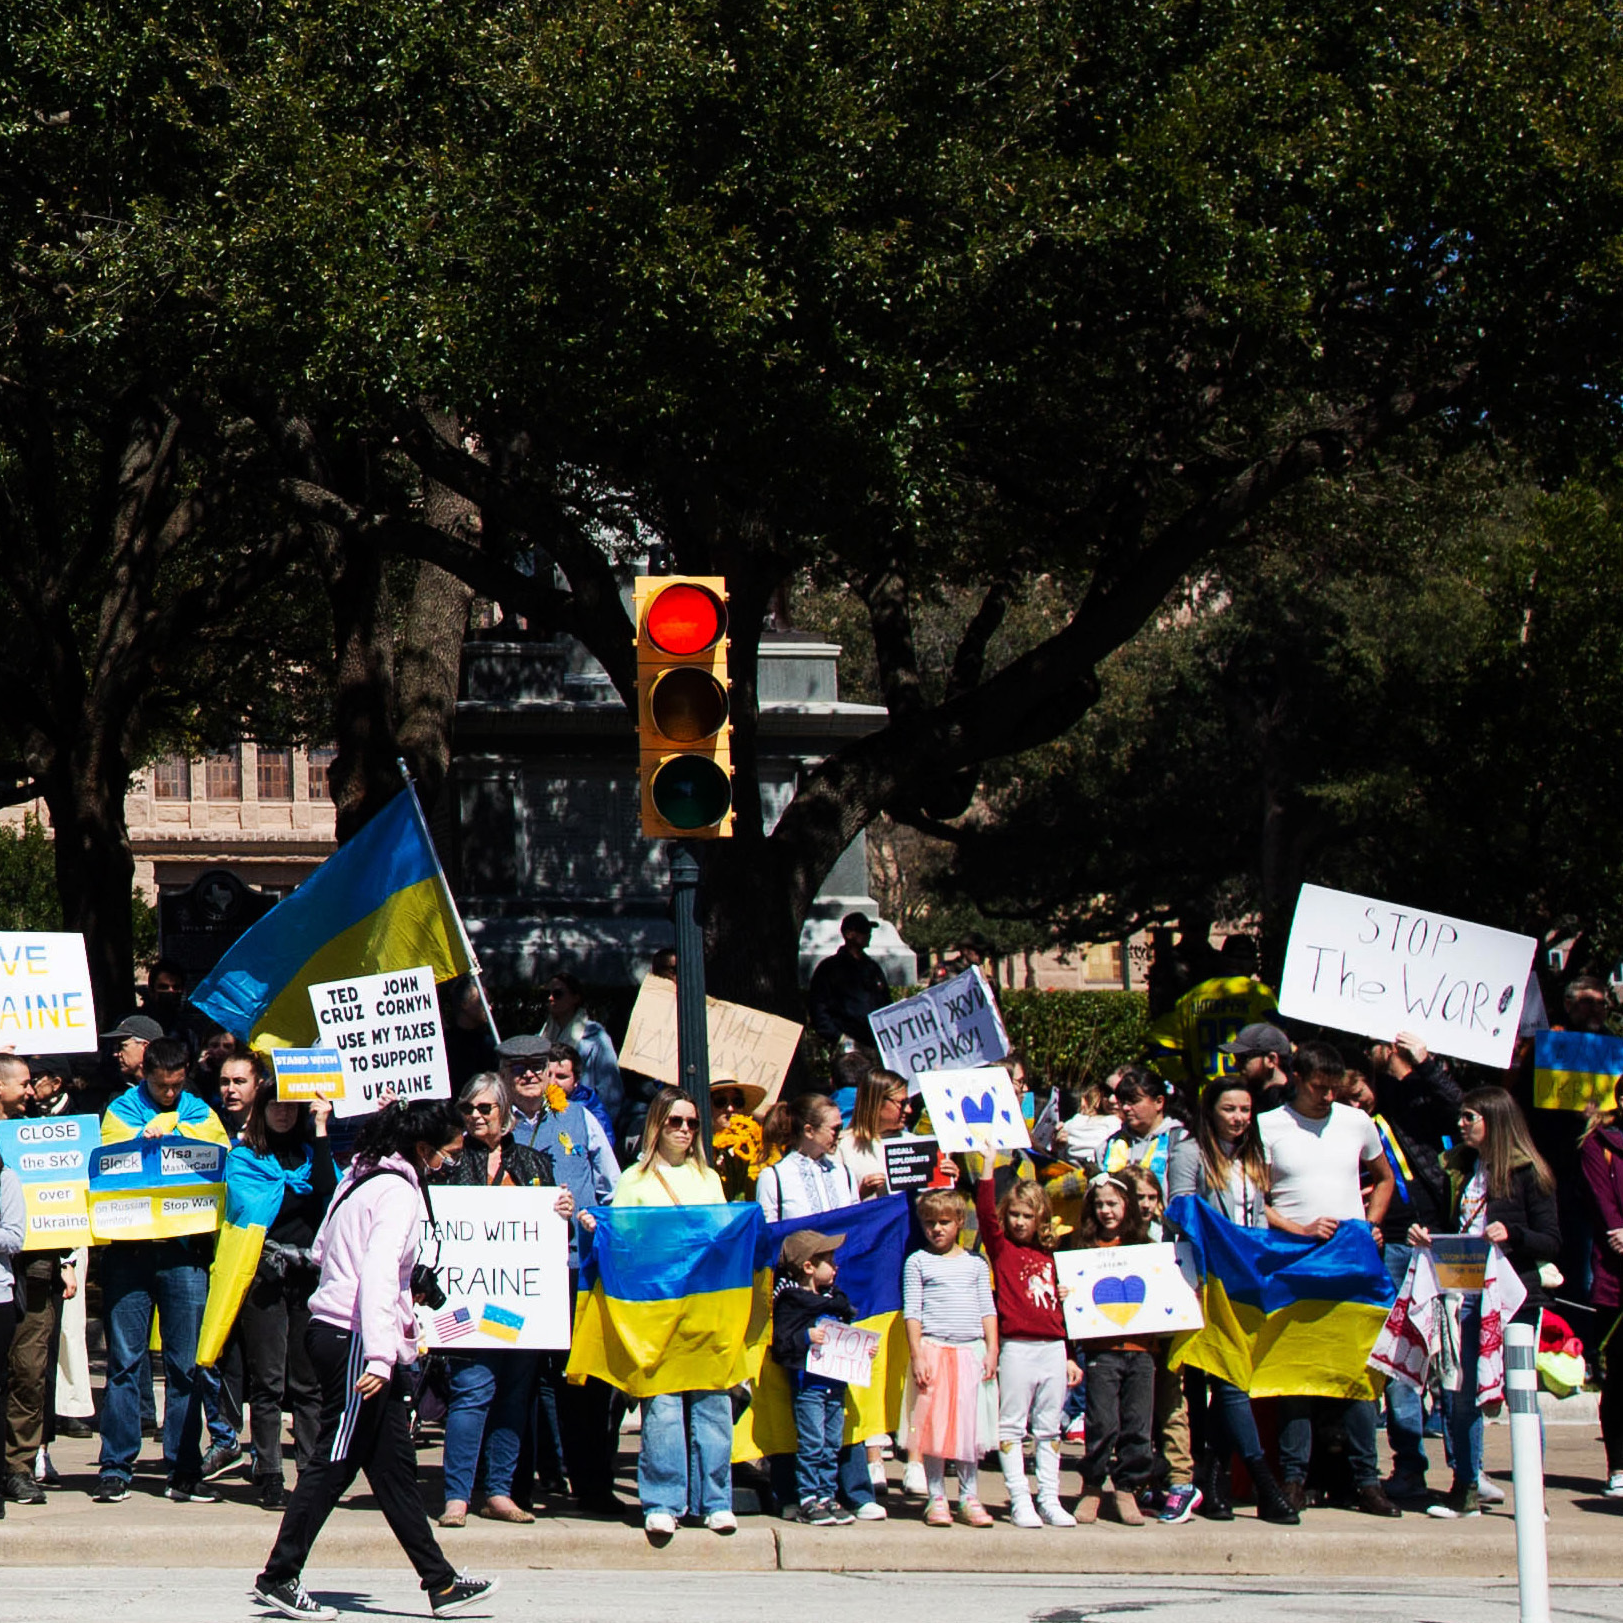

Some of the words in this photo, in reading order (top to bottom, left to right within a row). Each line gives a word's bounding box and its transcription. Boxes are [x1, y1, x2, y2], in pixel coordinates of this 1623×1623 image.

[1358, 907, 1458, 958] STOP
[1306, 945, 1386, 1004] The
[383, 975, 420, 997] JOHN
[327, 986, 358, 1005] TED
[376, 993, 432, 1017] CORNYN
[320, 1004, 365, 1025] CRUZ
[336, 1031, 367, 1050] USE
[371, 1027, 391, 1046] MY
[394, 1021, 436, 1042] TAXES
[275, 1055, 309, 1066] STAND
[311, 1055, 338, 1065] WITH
[350, 1055, 369, 1073] TO
[371, 1046, 434, 1070] SUPPORT
[363, 1074, 433, 1101] UKRAINE
[19, 1124, 77, 1141] CLOSE
[161, 1148, 192, 1160] Visa
[195, 1150, 212, 1158] and
[888, 1146, 915, 1156] RECALL
[22, 1157, 45, 1169] the
[49, 1155, 81, 1167] SKY
[100, 1155, 140, 1171] Block
[162, 1161, 217, 1173] MasterCard
[889, 1155, 930, 1166] DIPLOMATS
[890, 1166, 912, 1175] FROM
[38, 1188, 72, 1201] over
[110, 1200, 150, 1212] Russian
[163, 1200, 189, 1212] Stop
[32, 1214, 89, 1230] Ukraine
[420, 1220, 474, 1241] TAND
[484, 1220, 539, 1242] WITH
[434, 1266, 541, 1296] RAINE
[823, 1323, 876, 1358] STOP
